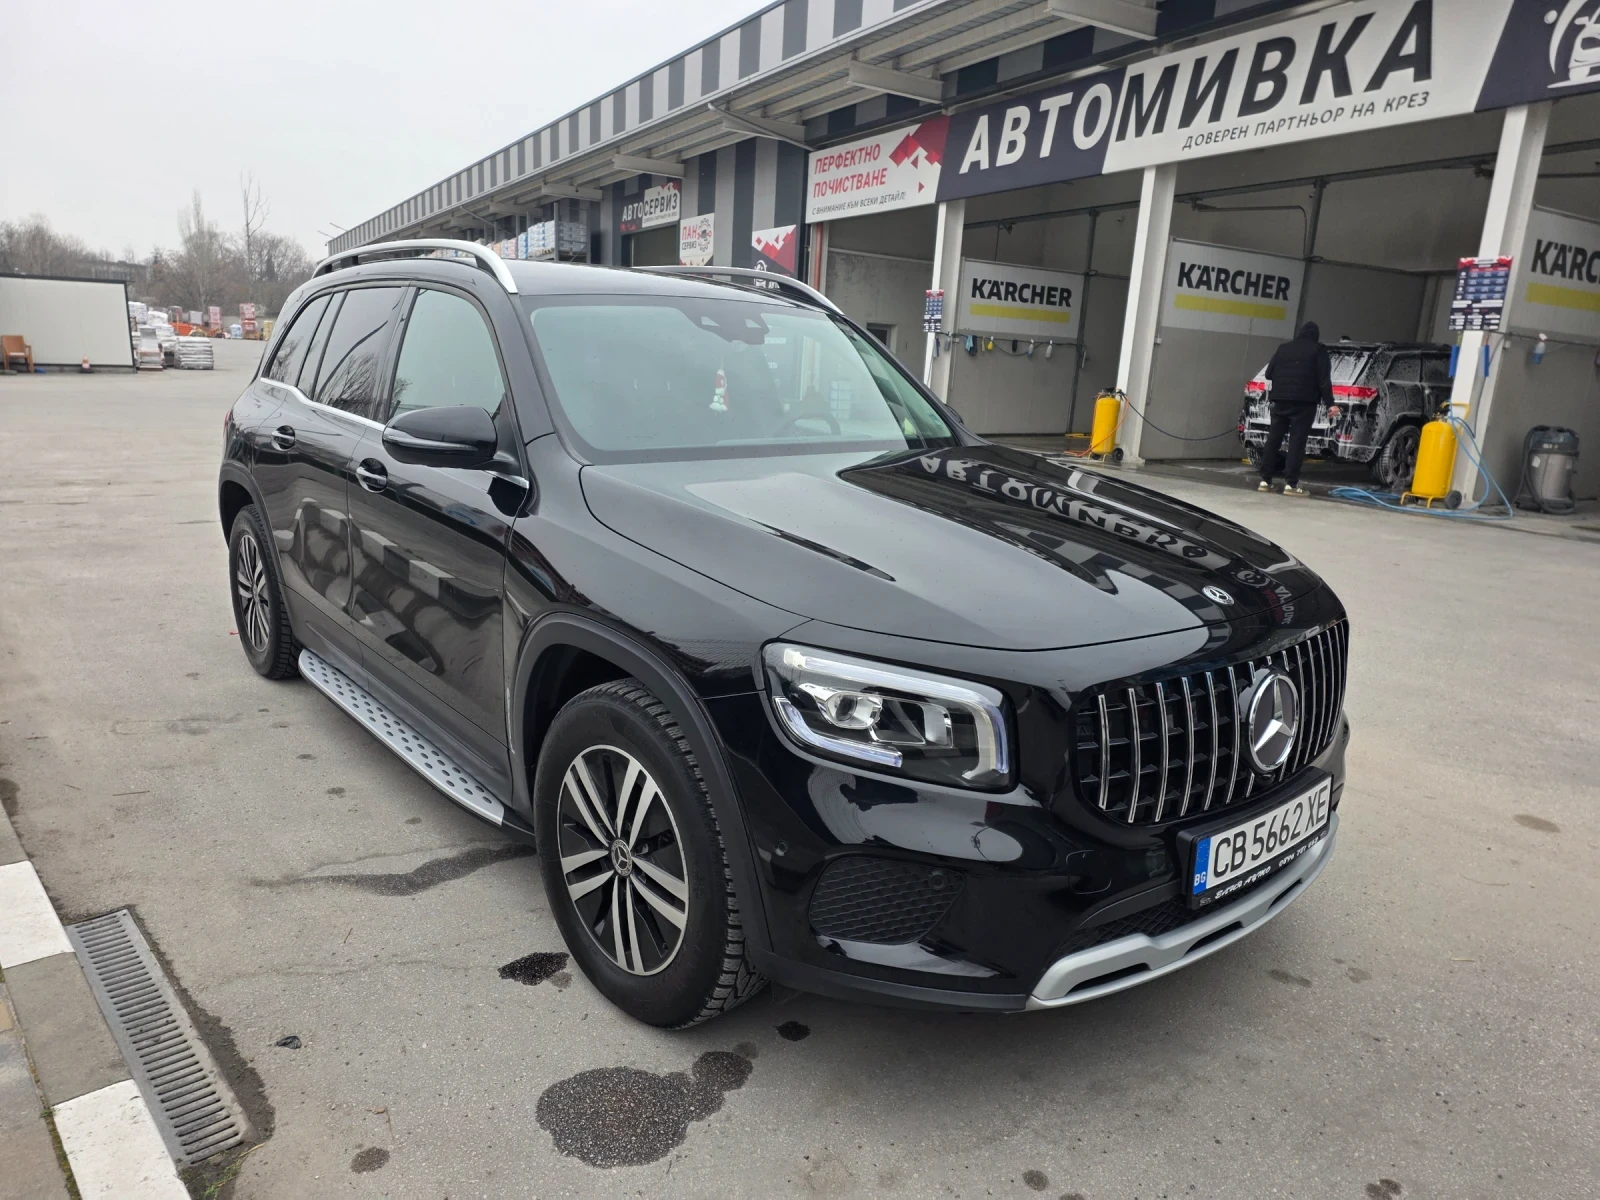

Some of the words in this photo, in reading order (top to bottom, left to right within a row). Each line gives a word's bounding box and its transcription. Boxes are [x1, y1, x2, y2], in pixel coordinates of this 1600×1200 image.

[959, 0, 1433, 175] АВТОМИВКА
[1182, 123, 1249, 152] ДОВЕРЕН
[1254, 106, 1345, 139] ПАРТНЬОР
[1350, 101, 1377, 119] НА
[1383, 90, 1430, 113] КРЕЗ
[814, 143, 881, 175] ПЕРФЕКТНО
[812, 167, 888, 199] ПОЧИСТВАНЕ
[621, 192, 679, 222] АВТОСЕРВИЗ
[811, 207, 816, 216] С
[816, 202, 847, 215] ВНИМАНИЕ
[846, 200, 860, 210] КЪМ
[859, 196, 879, 208] ВСЕКИ
[681, 224, 698, 241] ПАН
[1531, 238, 1600, 285] KÄRC
[971, 278, 1073, 308] KÄRCHER
[1178, 262, 1291, 302] KÄRCHER
[1251, 801, 1304, 861] 5662
[1193, 871, 1207, 887] BG
